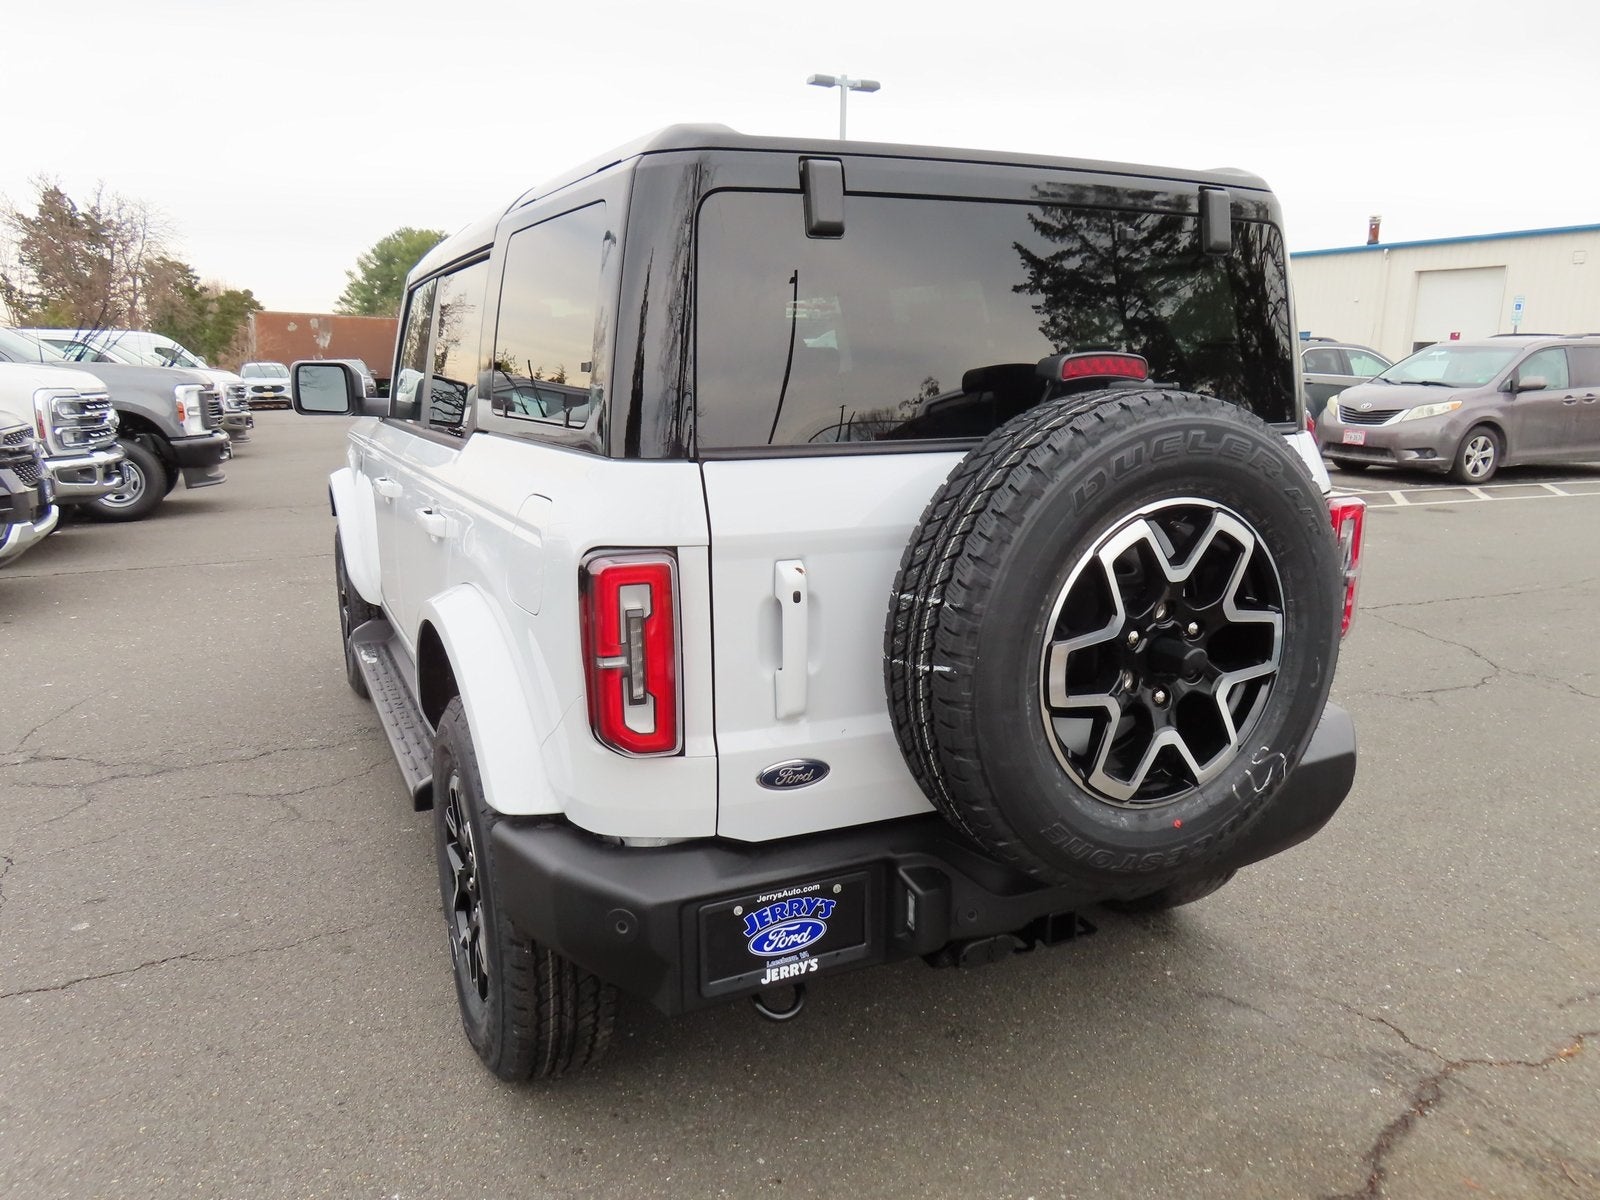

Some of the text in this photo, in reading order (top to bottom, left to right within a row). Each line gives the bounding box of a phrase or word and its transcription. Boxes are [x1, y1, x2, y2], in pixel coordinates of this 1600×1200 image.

[1071, 429, 1284, 514] DUELER
[774, 765, 815, 786] Ford
[756, 884, 820, 903] JerrysAuto.com
[742, 896, 837, 938] JERRY'S
[763, 924, 813, 952] Ford
[760, 957, 819, 985] JERRY'S
